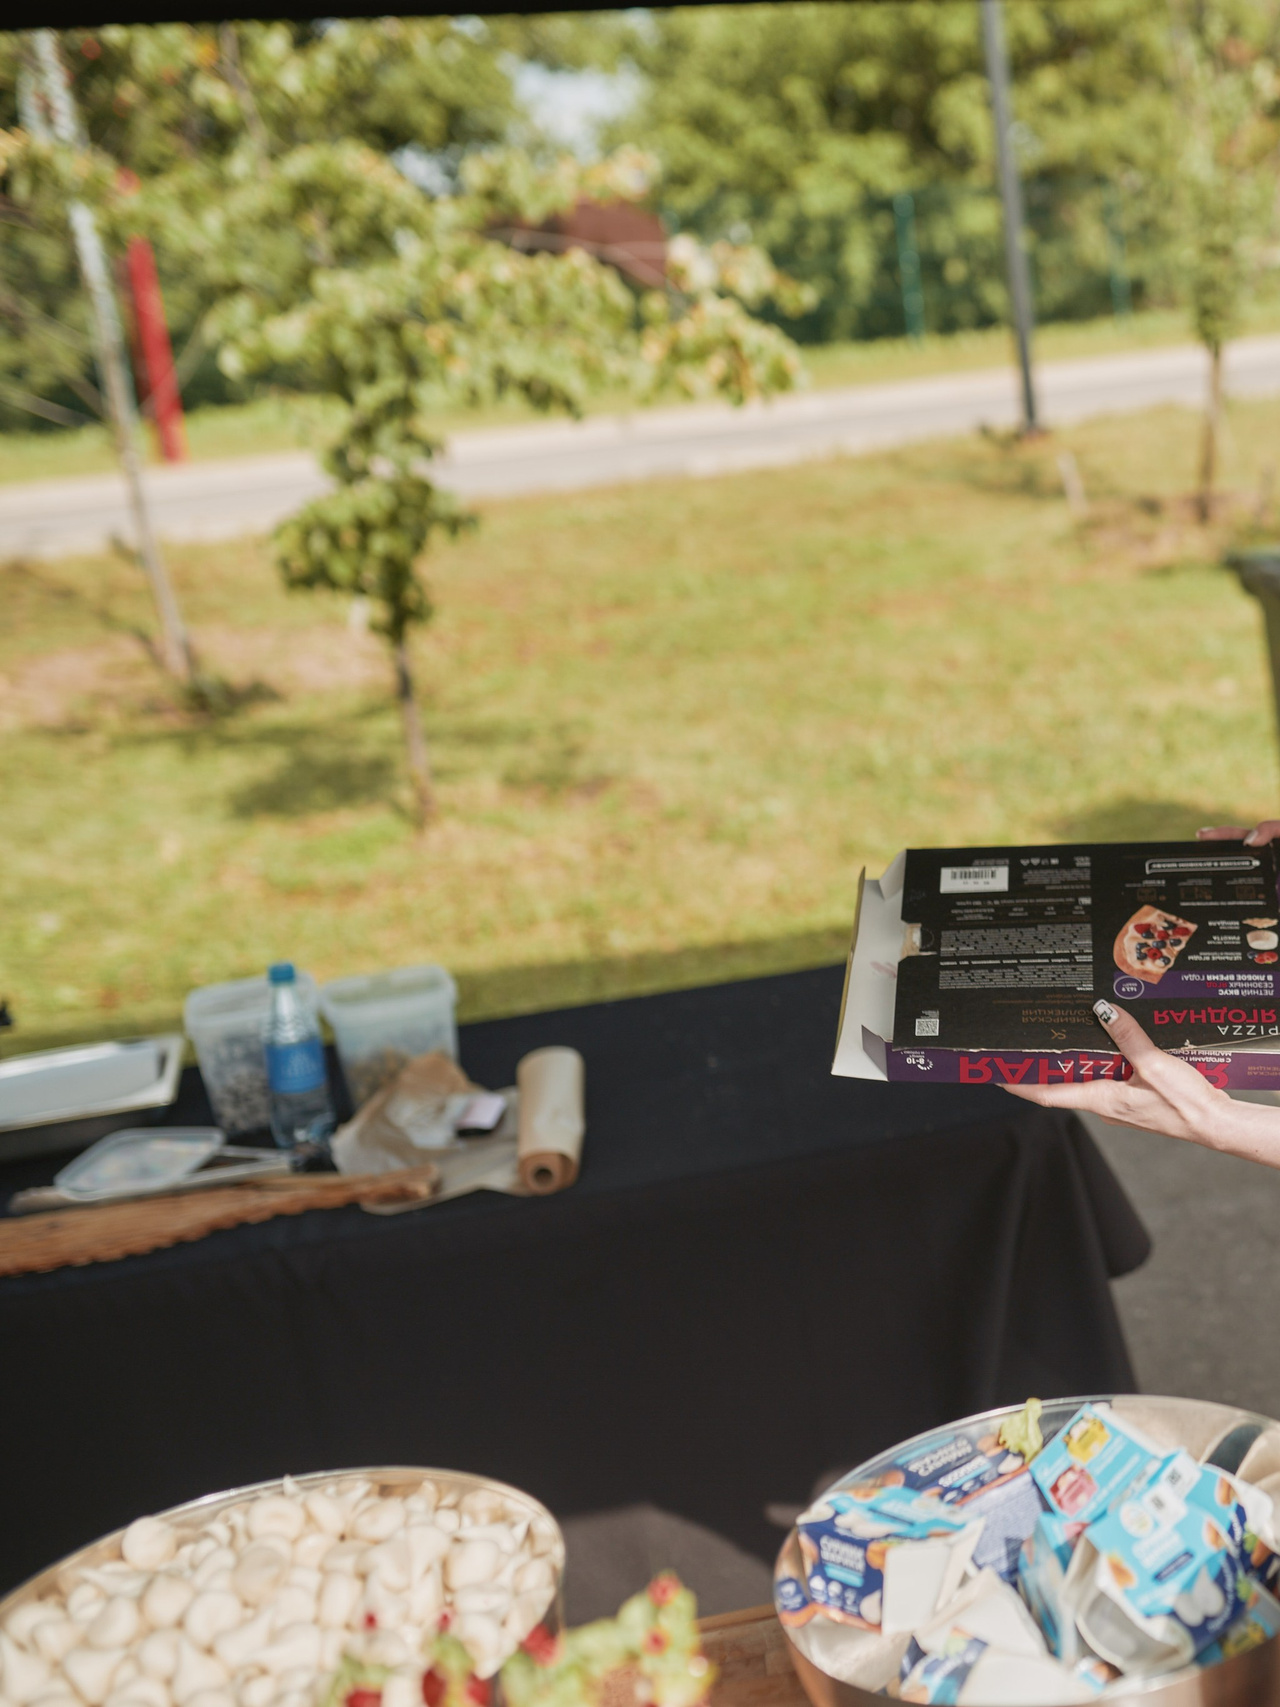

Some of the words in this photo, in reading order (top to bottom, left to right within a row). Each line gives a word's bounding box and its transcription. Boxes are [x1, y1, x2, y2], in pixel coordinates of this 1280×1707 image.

[1022, 1008, 1094, 1016] КОЛЛЕКЦИЯ
[1153, 1006, 1277, 1024] ЯГОДНАЯ
[1216, 1025, 1279, 1035] PIZZA
